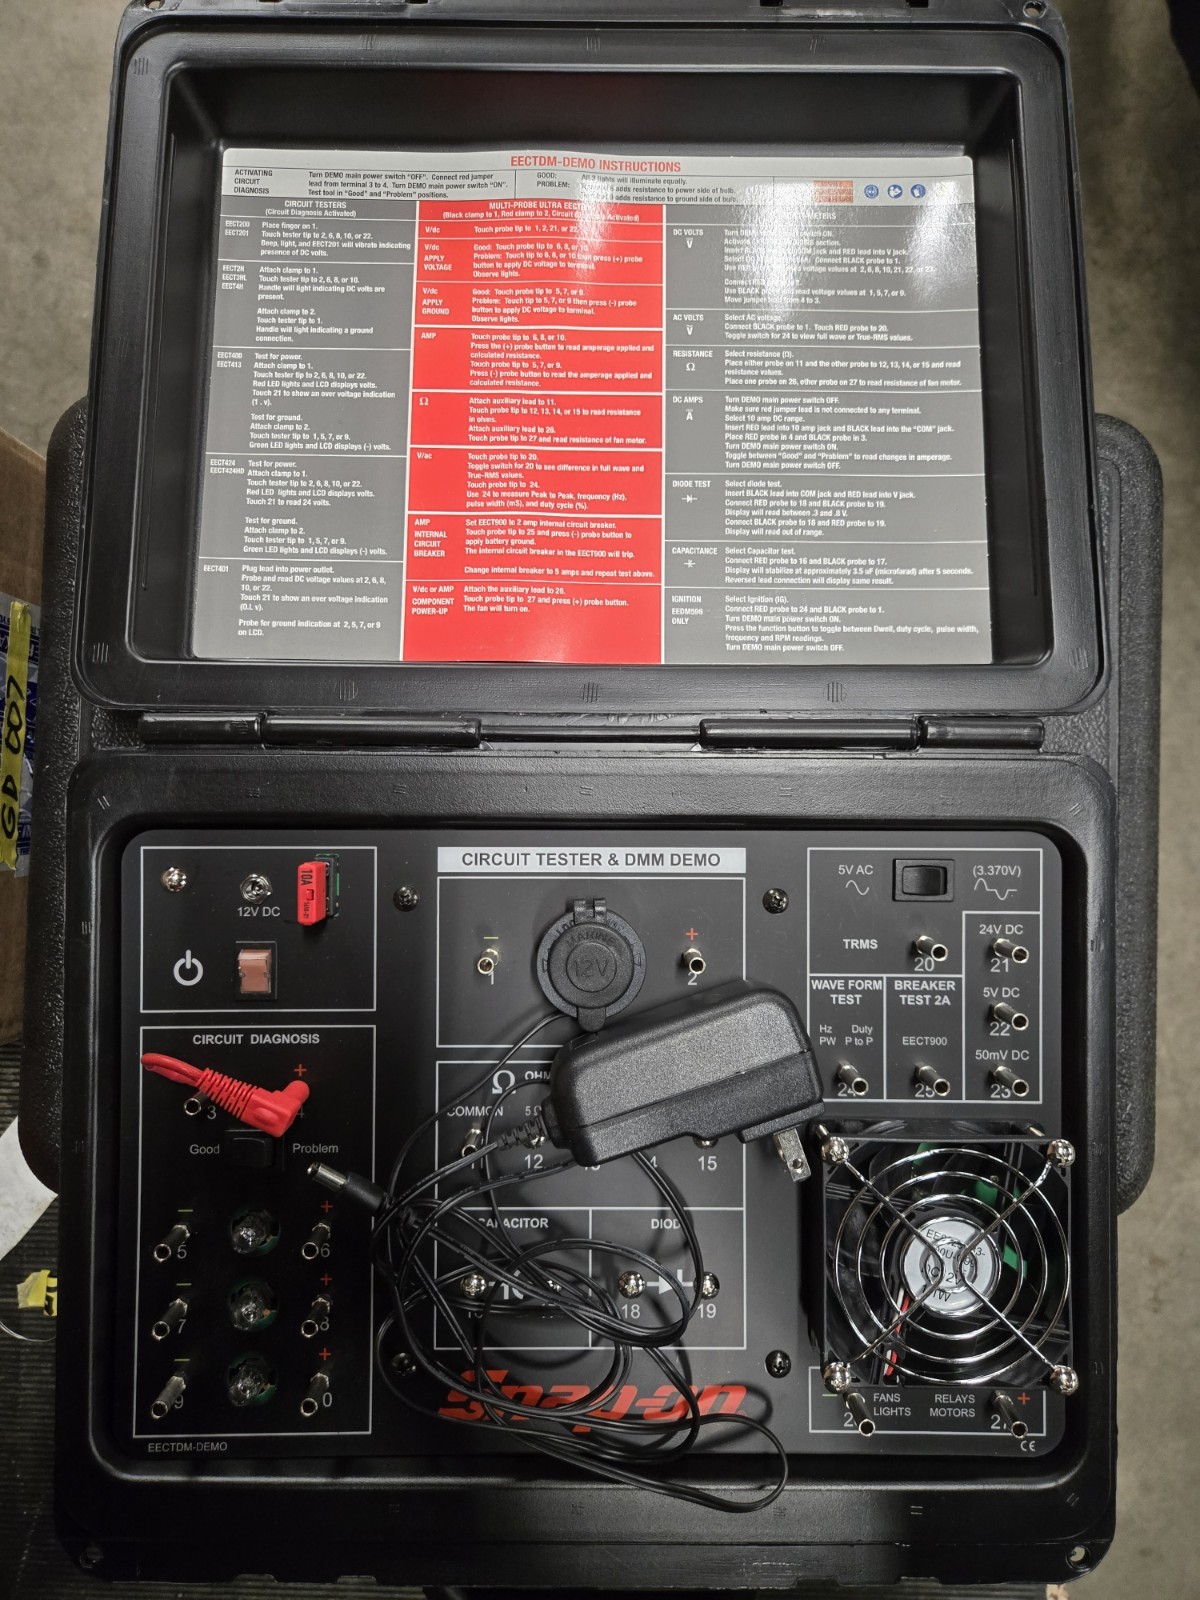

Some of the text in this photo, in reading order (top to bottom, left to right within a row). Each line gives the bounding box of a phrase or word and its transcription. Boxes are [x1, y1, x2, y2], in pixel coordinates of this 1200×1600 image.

[510, 155, 680, 172] EECTDM-DEMO INSTRUCTIONS
[233, 186, 269, 194] DIAGNOSIS
[315, 200, 346, 208] TESTERS
[489, 201, 537, 209] MULTI-PROBE
[290, 208, 322, 216] Diagnosis
[281, 221, 300, 230] finger
[210, 458, 235, 466] EECT424
[203, 564, 228, 572] EECT401
[241, 564, 257, 573] Plug
[2, 674, 25, 839] GD 007
[461, 852, 720, 866] CIRCUIT TESTER & DMM DEMO
[838, 864, 873, 875] 5V AC
[972, 865, 1021, 877] (3.370V)
[300, 869, 313, 886] 10A
[237, 906, 280, 916] 12V DC
[979, 924, 1023, 934] 24V DC
[843, 938, 877, 949] TRMS
[573, 958, 610, 978] 12V
[914, 957, 935, 972] 20
[990, 958, 1010, 973] 21
[687, 972, 698, 986] 2
[811, 979, 884, 989] WAVE FORM
[894, 980, 955, 990] BREAKER
[983, 987, 1019, 997] 5V DC
[830, 994, 862, 1004] TEST
[899, 994, 950, 1005] TEST 2A
[819, 1024, 832, 1033] Hz
[851, 1024, 872, 1035] Duty
[989, 1022, 1011, 1037] 22
[192, 1033, 319, 1044] CIRCUIT DIAGNOSIS
[819, 1036, 836, 1045] PW
[845, 1036, 873, 1045] P to P
[902, 1036, 947, 1045] EECT900
[975, 1049, 1029, 1060] 50mV DC
[915, 1083, 936, 1098] 25
[990, 1084, 1012, 1099] 23
[207, 1106, 217, 1120] 3
[525, 1106, 530, 1117] 5
[189, 1143, 219, 1154] Good
[292, 1142, 338, 1153] Problem
[524, 1154, 543, 1169] 12
[698, 1156, 717, 1171] 15
[177, 1244, 187, 1259] 5
[320, 1243, 330, 1258] 6
[622, 1304, 641, 1319] 18
[697, 1303, 716, 1319] 19
[177, 1319, 187, 1334] 7
[873, 1392, 900, 1402] FANS
[934, 1394, 975, 1403] RELAYS
[873, 1406, 911, 1416] LIGHTS
[929, 1407, 975, 1417] MOTORS
[148, 1441, 227, 1452] EECTDM-DEMO
